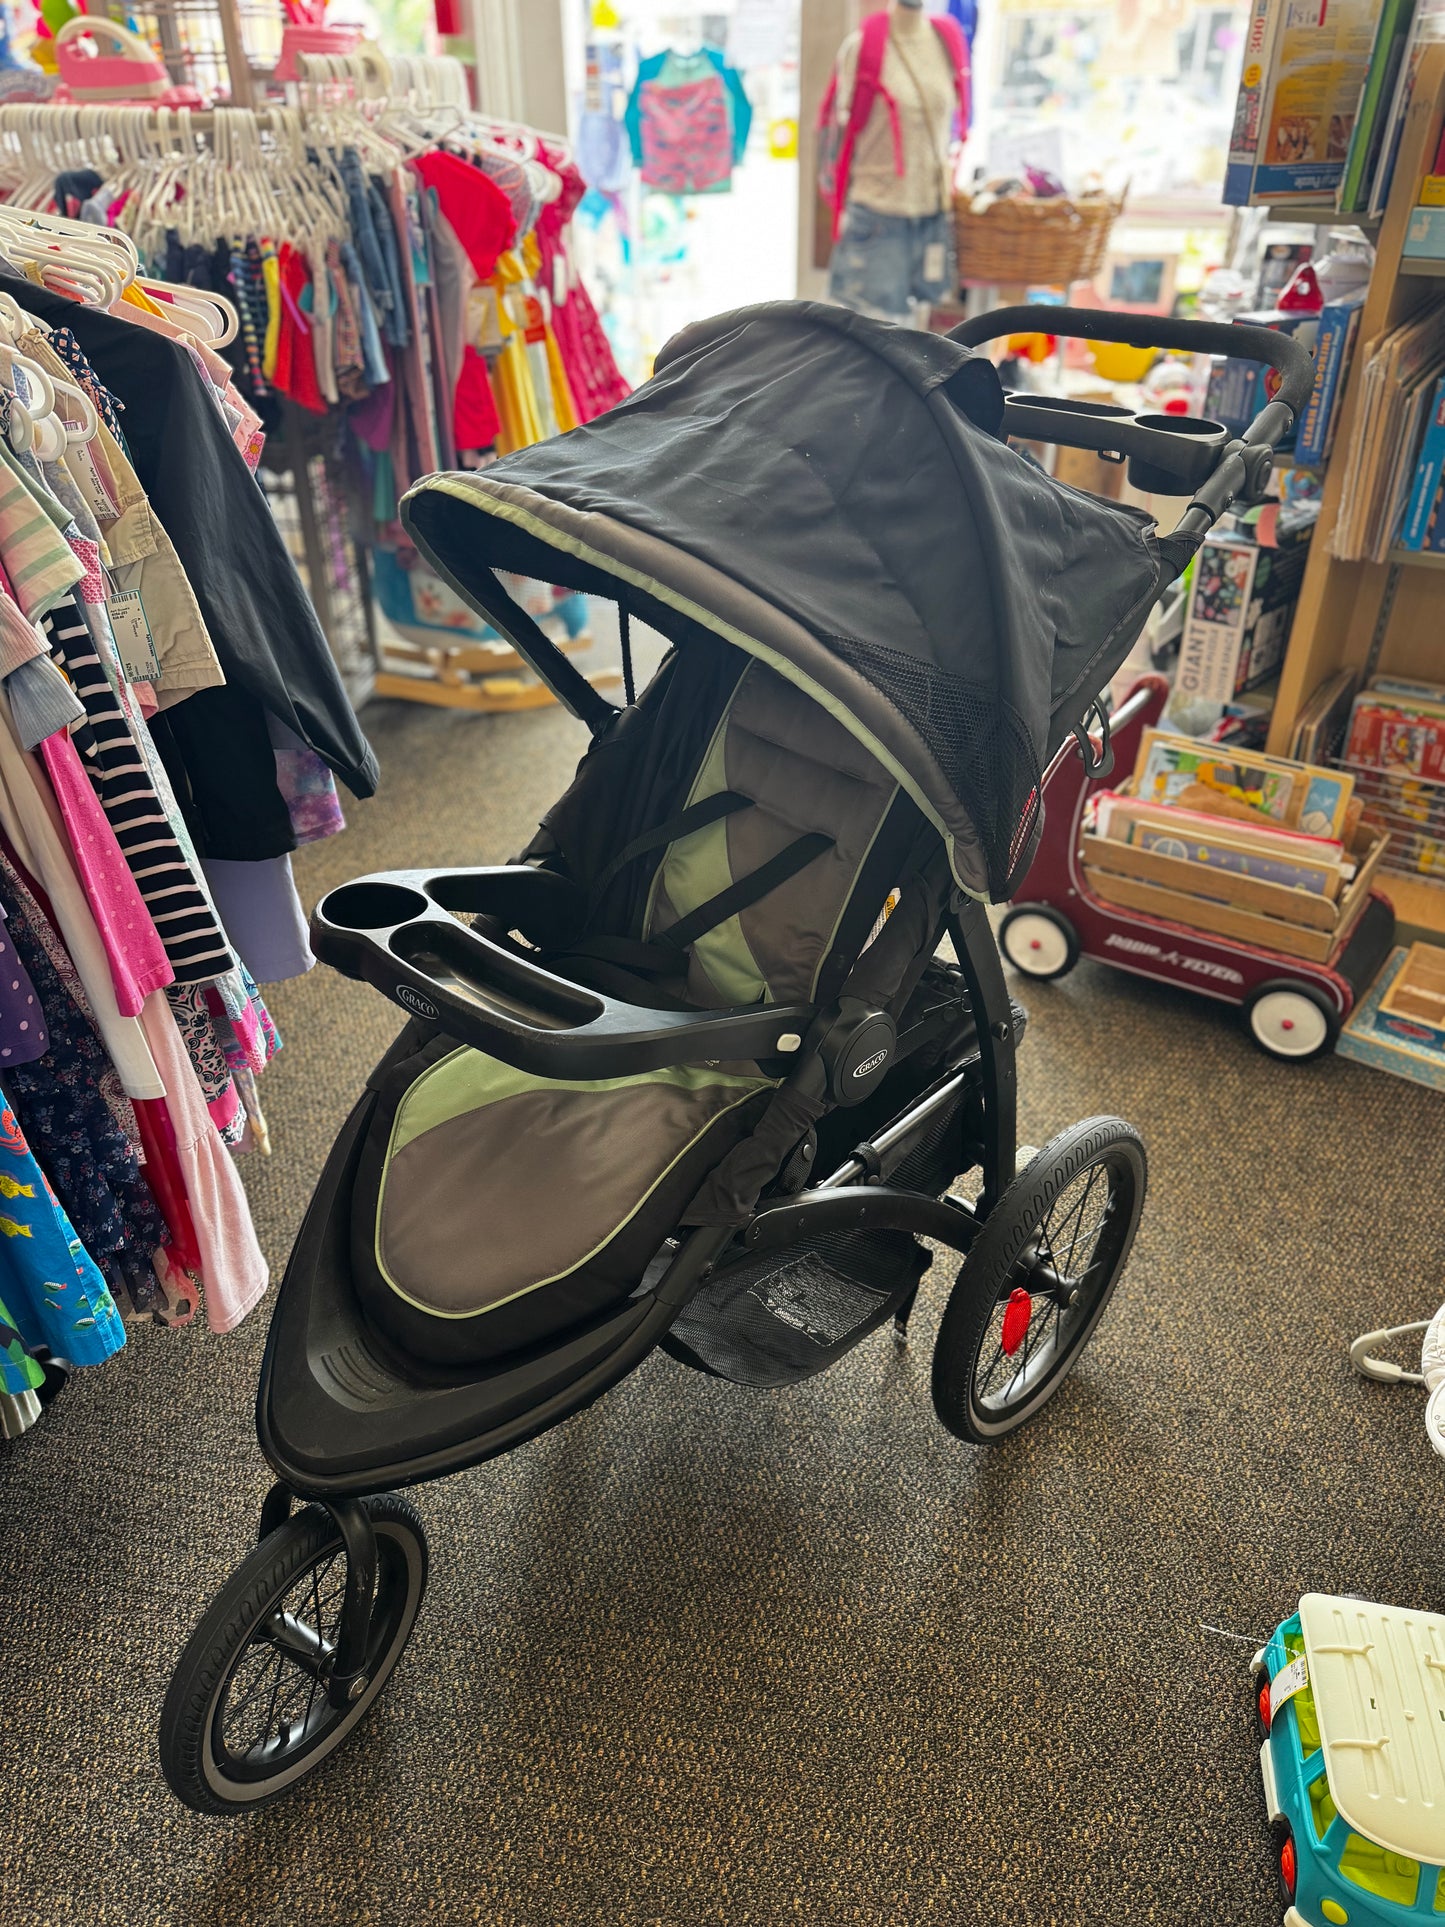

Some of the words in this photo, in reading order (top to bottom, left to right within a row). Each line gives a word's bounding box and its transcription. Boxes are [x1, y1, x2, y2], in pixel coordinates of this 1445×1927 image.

[1314, 332, 1332, 388] LOOKING
[1309, 390, 1321, 407] BY
[1302, 408, 1318, 447] LEARN
[1182, 626, 1206, 691] GIANT
[1181, 959, 1245, 984] FLYER
[402, 989, 434, 1015] GRACO
[858, 1052, 886, 1074] GRACO
